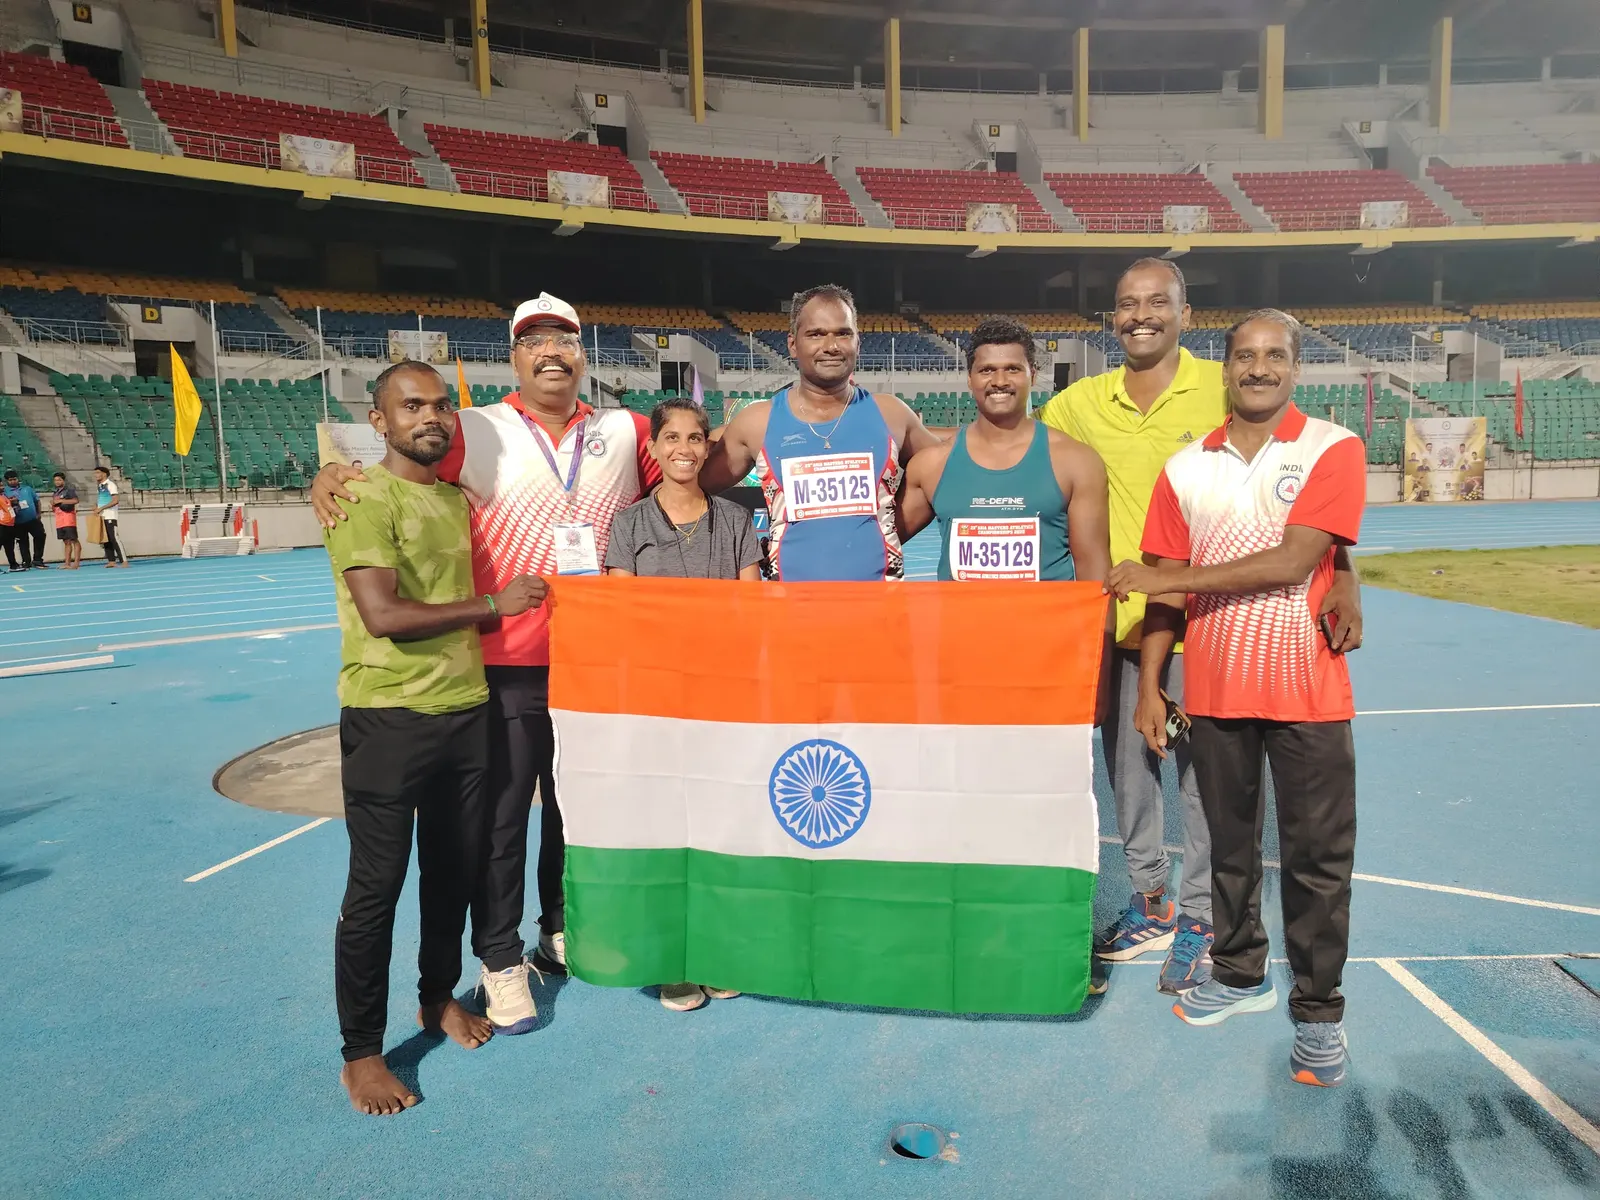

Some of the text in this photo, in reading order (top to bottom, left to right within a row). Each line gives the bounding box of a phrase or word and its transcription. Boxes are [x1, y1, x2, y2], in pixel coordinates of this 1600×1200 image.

[598, 95, 606, 105] D
[991, 126, 998, 135] D
[1363, 122, 1369, 131] E
[145, 307, 158, 320] D
[658, 336, 668, 347] D
[1434, 333, 1443, 342] E
[1048, 341, 1057, 350] D
[793, 475, 870, 505] M-35125
[972, 497, 1024, 505] RE-DEFINE
[754, 513, 765, 528] 7
[959, 541, 1034, 567] M-35129
